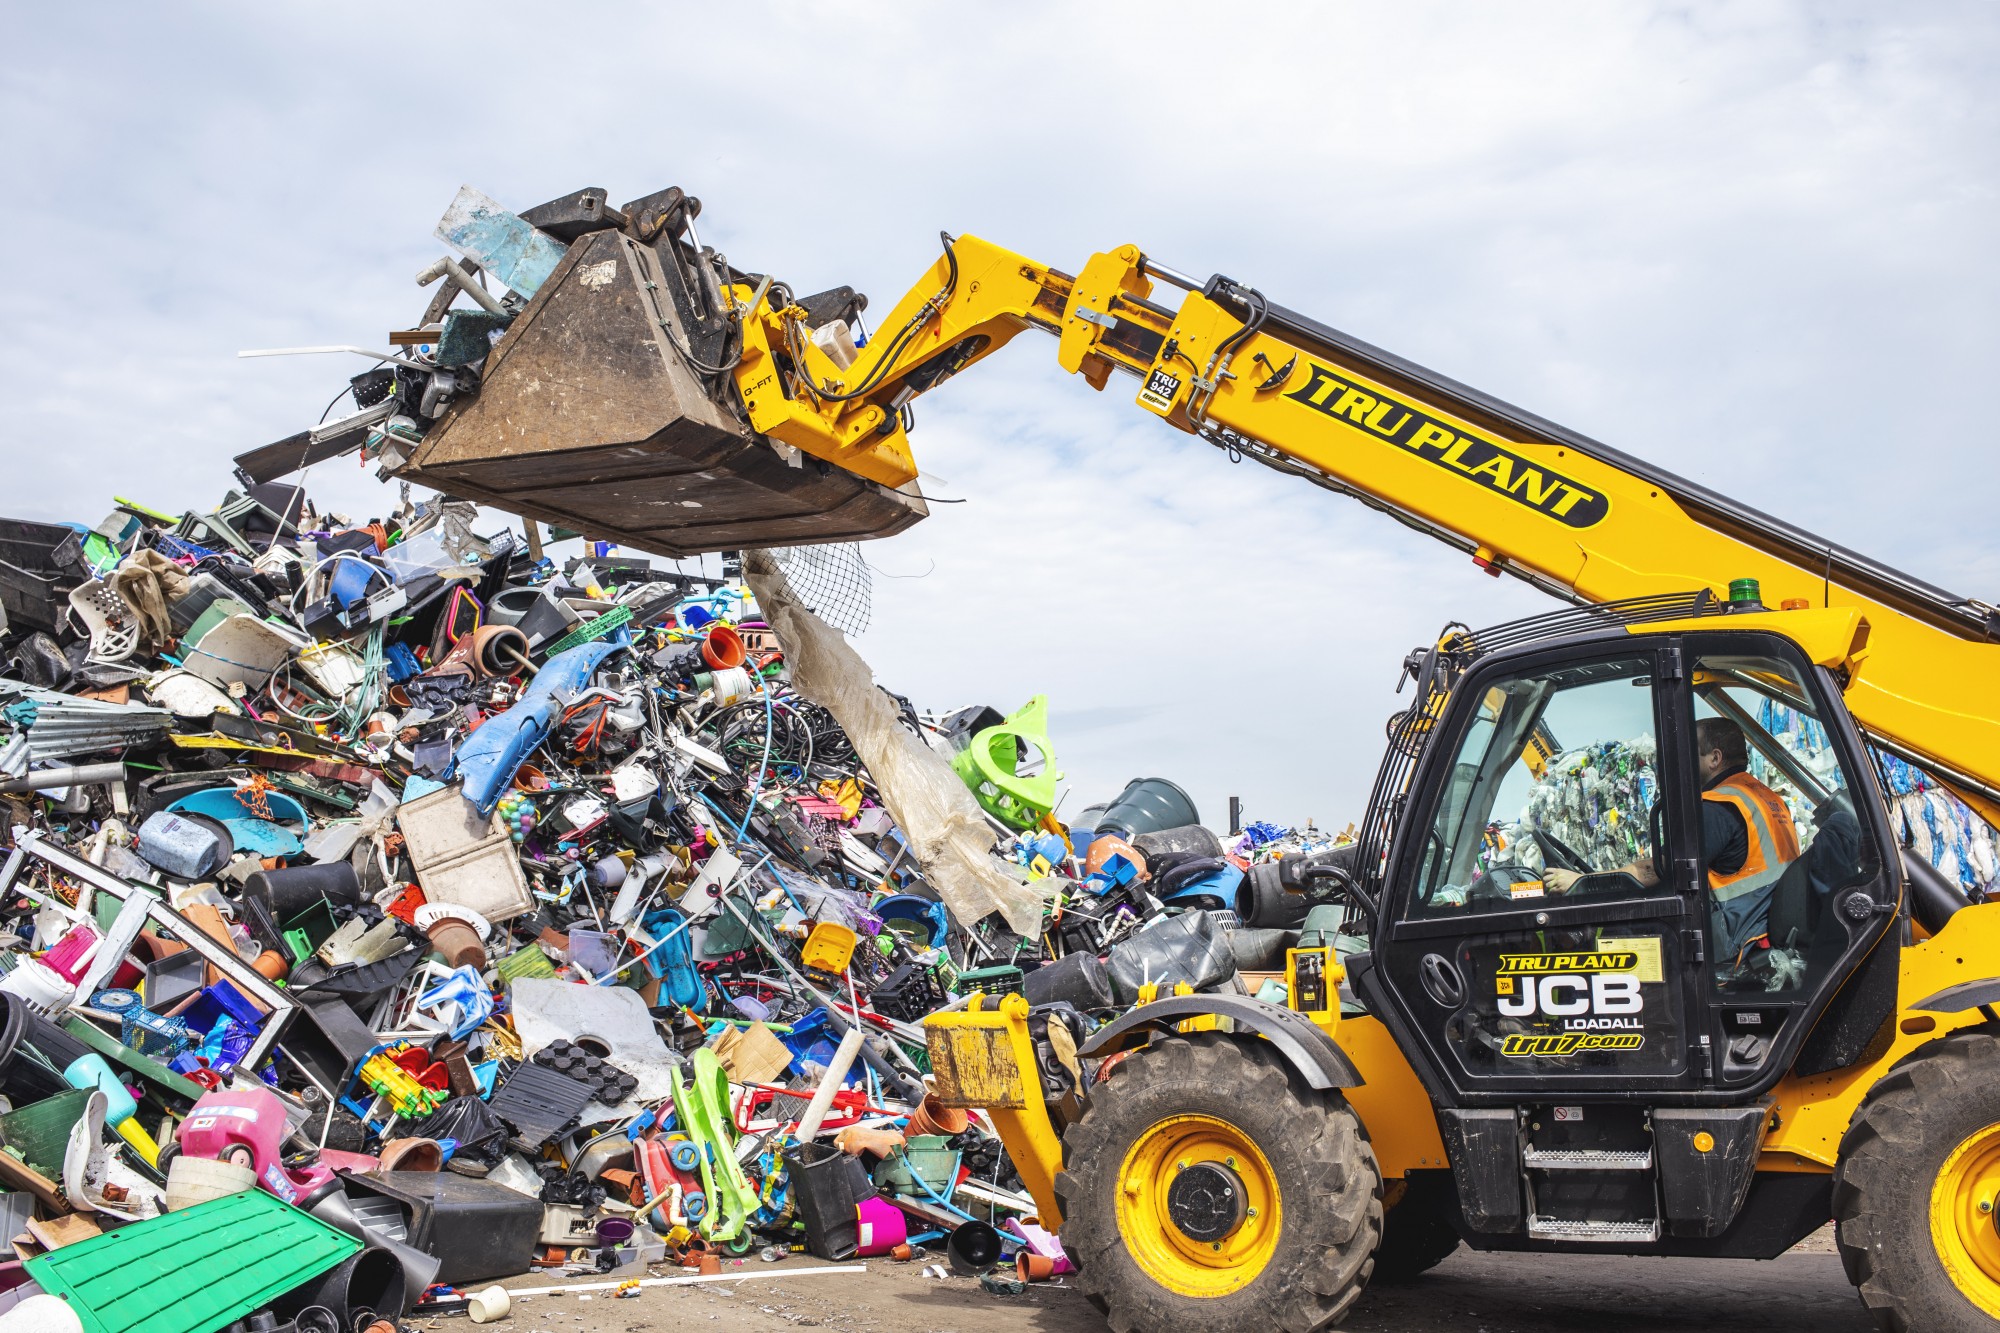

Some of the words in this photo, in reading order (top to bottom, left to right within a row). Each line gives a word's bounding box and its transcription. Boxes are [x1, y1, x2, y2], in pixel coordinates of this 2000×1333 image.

[1155, 371, 1179, 389] TRU
[1150, 381, 1172, 398] 942
[1308, 374, 1411, 437] TRU
[1405, 421, 1594, 517] PLANT
[1507, 957, 1550, 970] TRU
[1553, 954, 1631, 969] PLANT
[1497, 974, 1643, 1016] JCB
[1564, 1018, 1644, 1030] LOADALL
[1502, 1033, 1643, 1056] tru7.com
